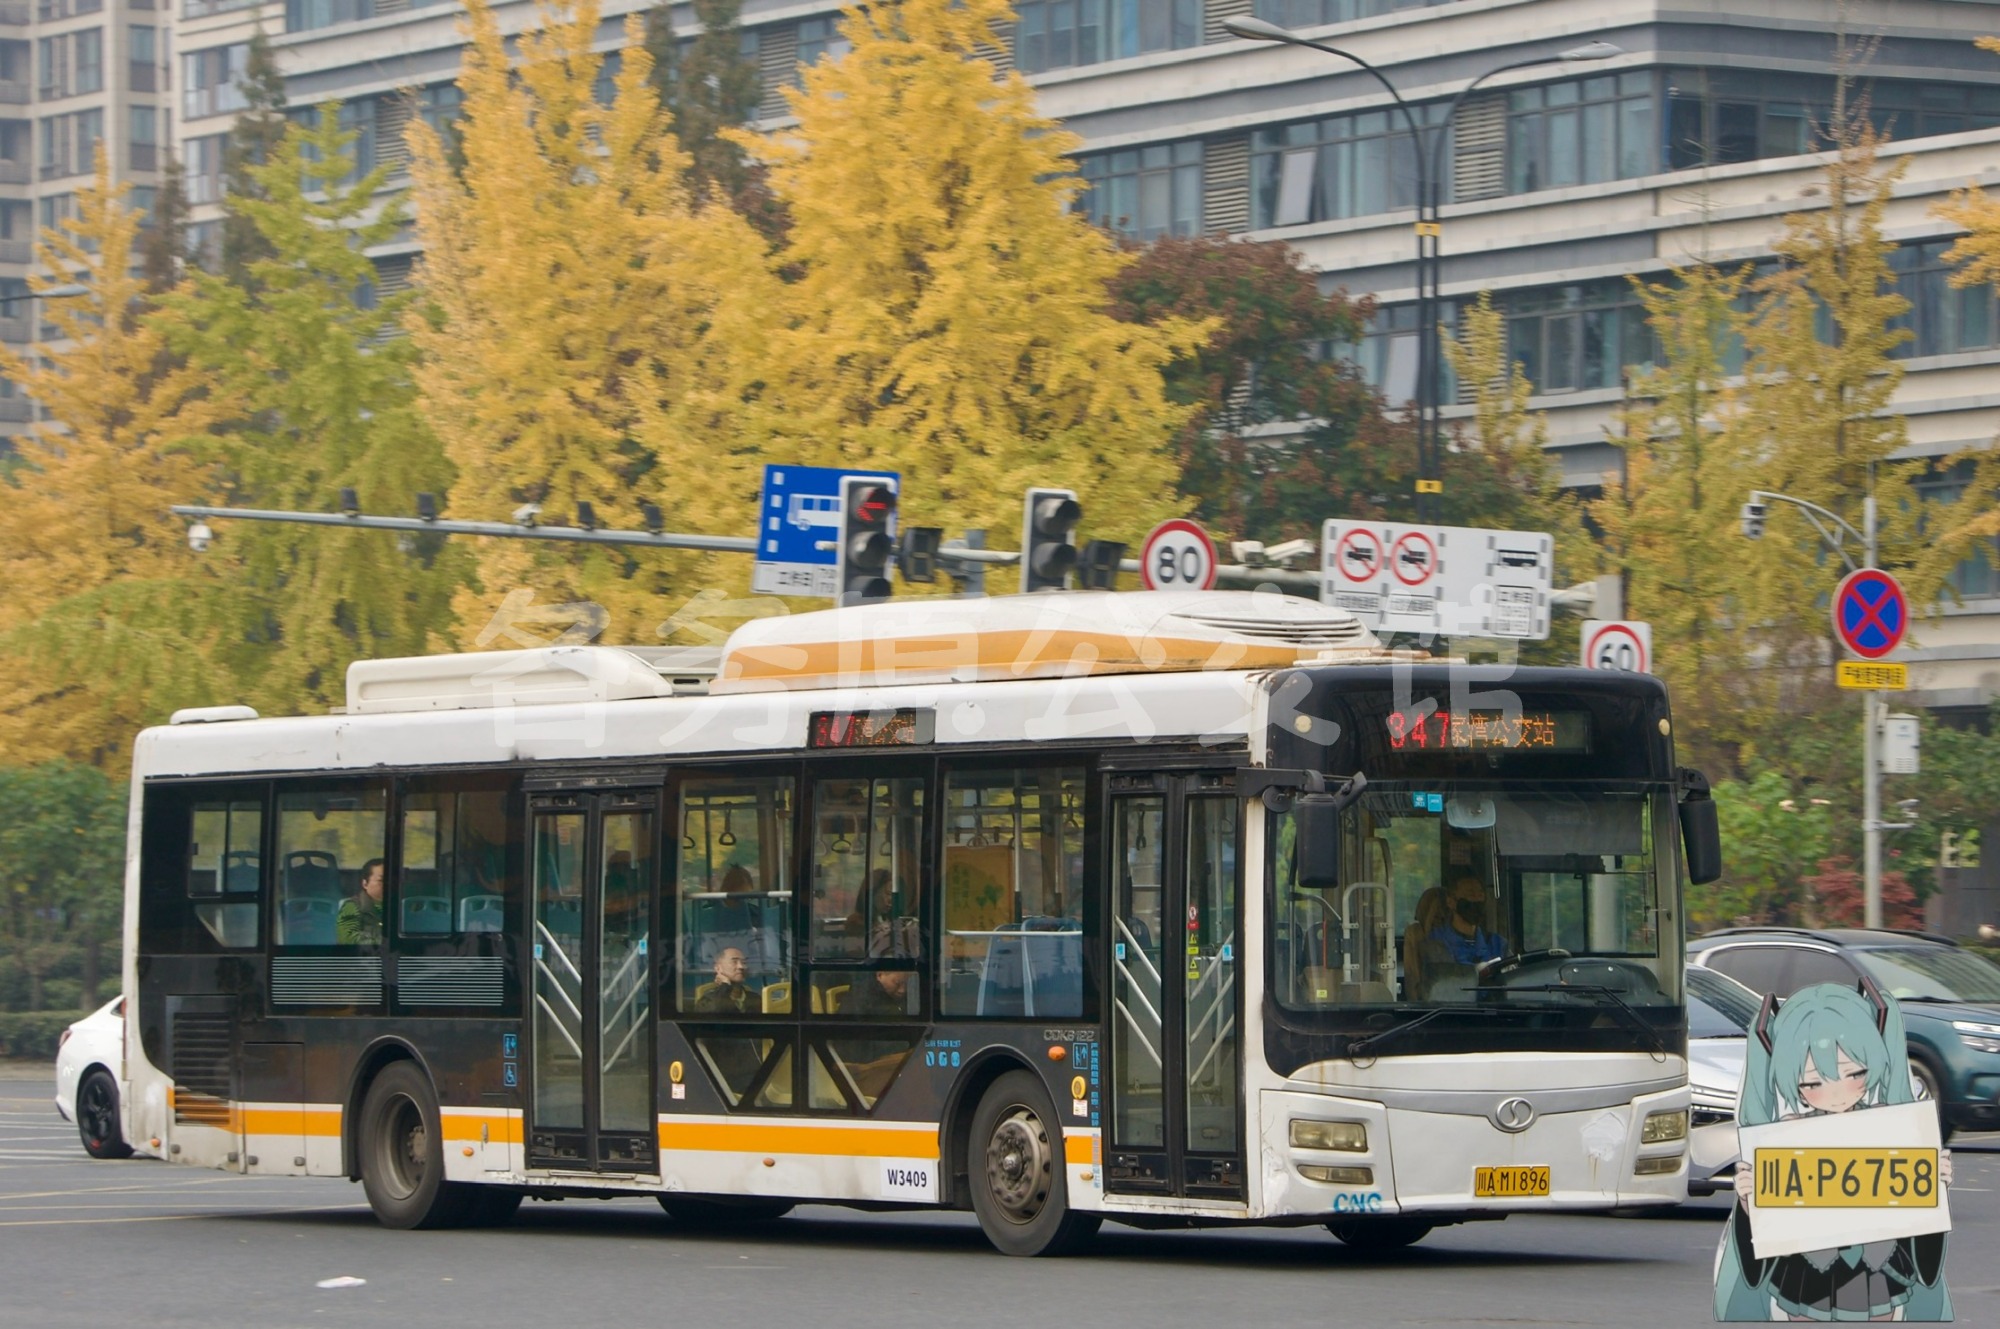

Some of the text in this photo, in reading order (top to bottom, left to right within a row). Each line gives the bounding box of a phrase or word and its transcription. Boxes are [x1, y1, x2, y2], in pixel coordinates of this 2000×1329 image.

[1158, 546, 1202, 584] 80
[1599, 643, 1635, 671] 60
[1388, 712, 1450, 748] 347
[887, 1168, 927, 1188] W3409
[1477, 1170, 1548, 1192] 川A·M1896
[1333, 1193, 1382, 1213] CNG
